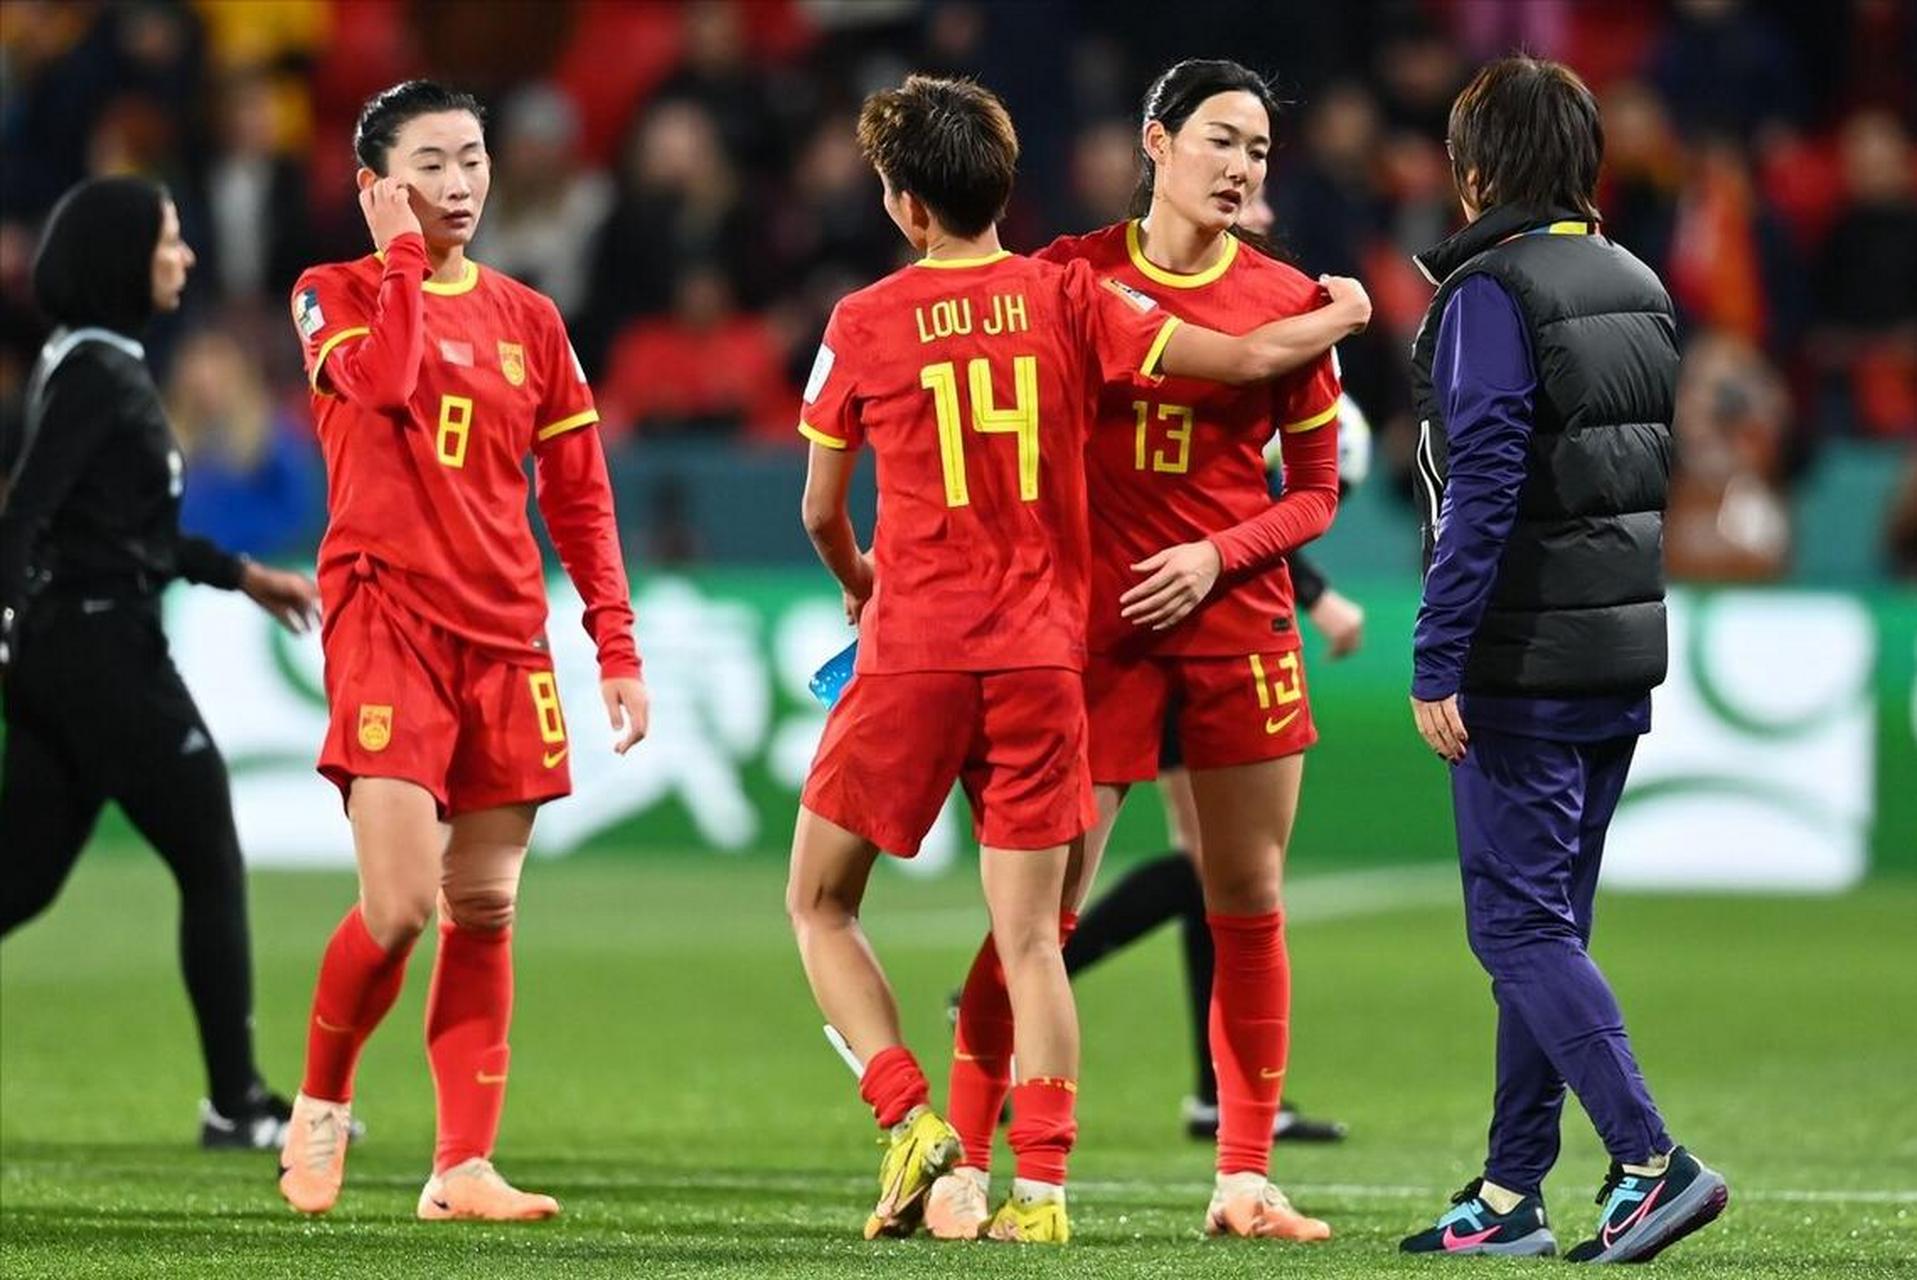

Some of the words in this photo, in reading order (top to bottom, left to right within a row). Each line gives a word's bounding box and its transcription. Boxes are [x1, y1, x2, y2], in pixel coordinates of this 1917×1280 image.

[915, 298, 972, 343] LOU
[983, 294, 1029, 335] JH
[436, 394, 473, 468] 8
[920, 356, 1039, 507] 14
[1132, 400, 1193, 473] 13
[528, 671, 567, 743] 8
